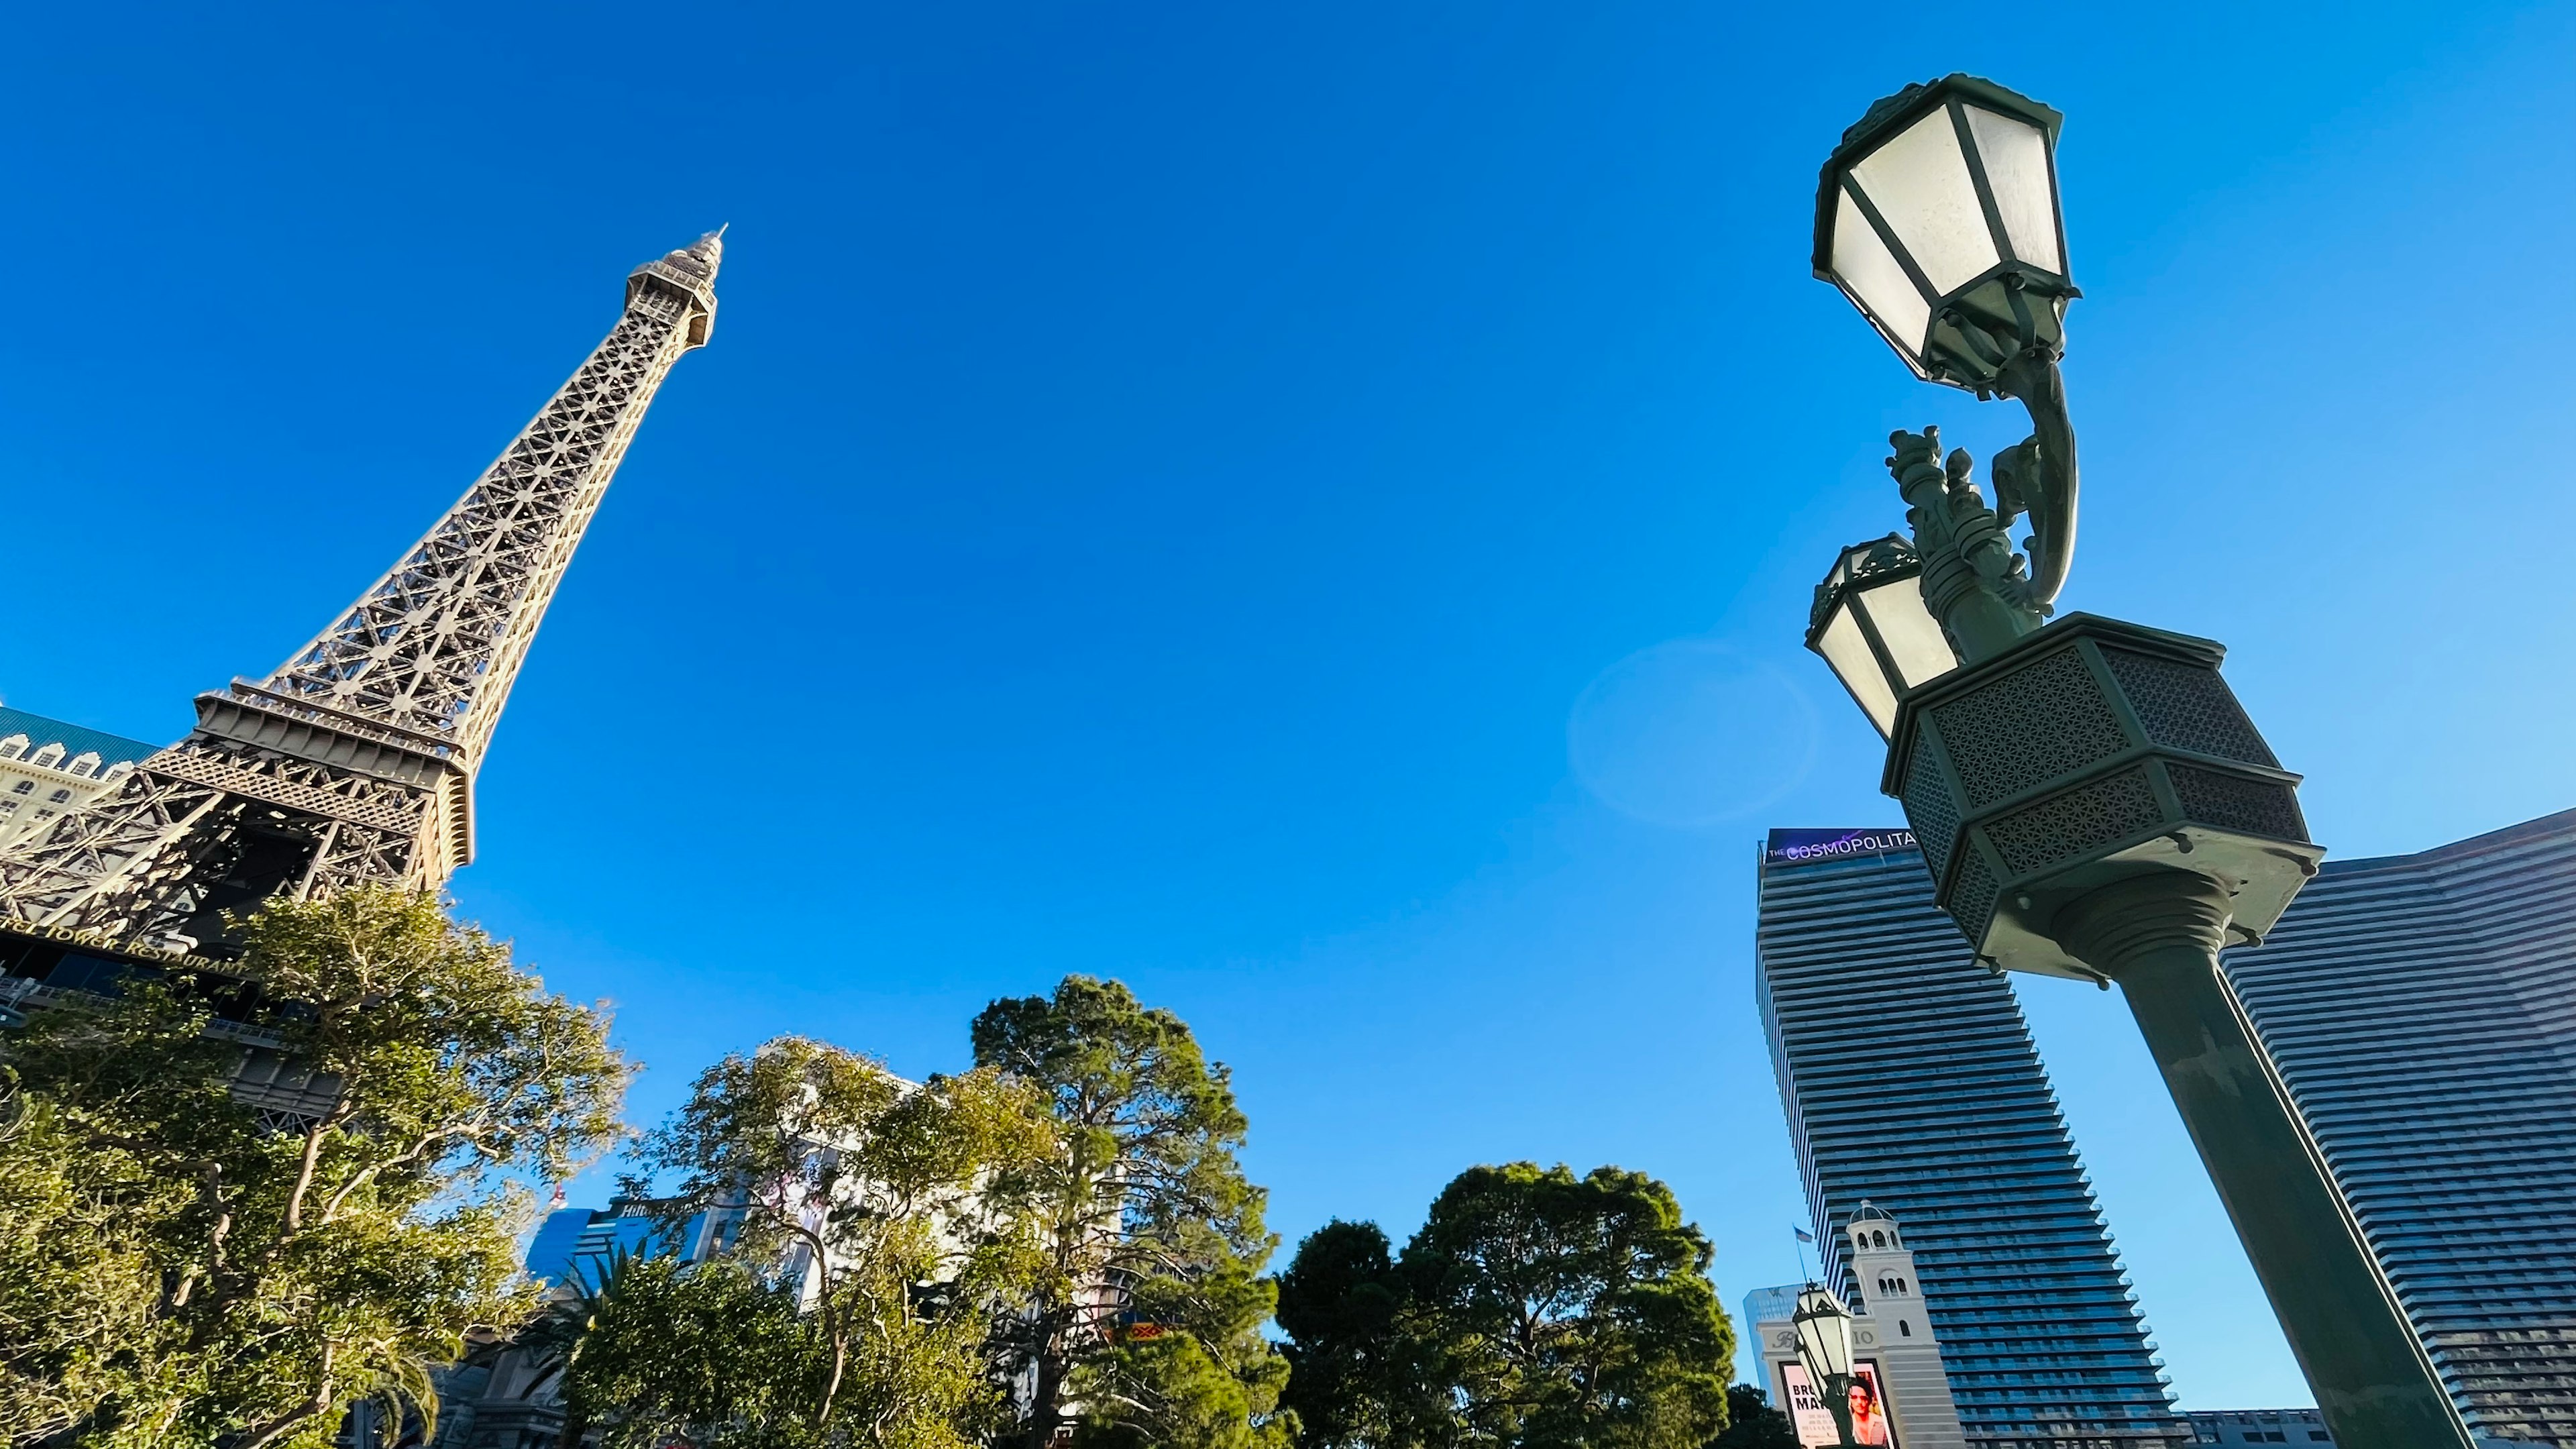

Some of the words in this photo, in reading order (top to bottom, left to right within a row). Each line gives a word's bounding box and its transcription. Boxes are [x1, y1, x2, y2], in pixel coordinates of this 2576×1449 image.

[1769, 848, 1786, 857] THE
[44, 923, 119, 950] TOWER
[124, 941, 249, 975] RESTAURANT
